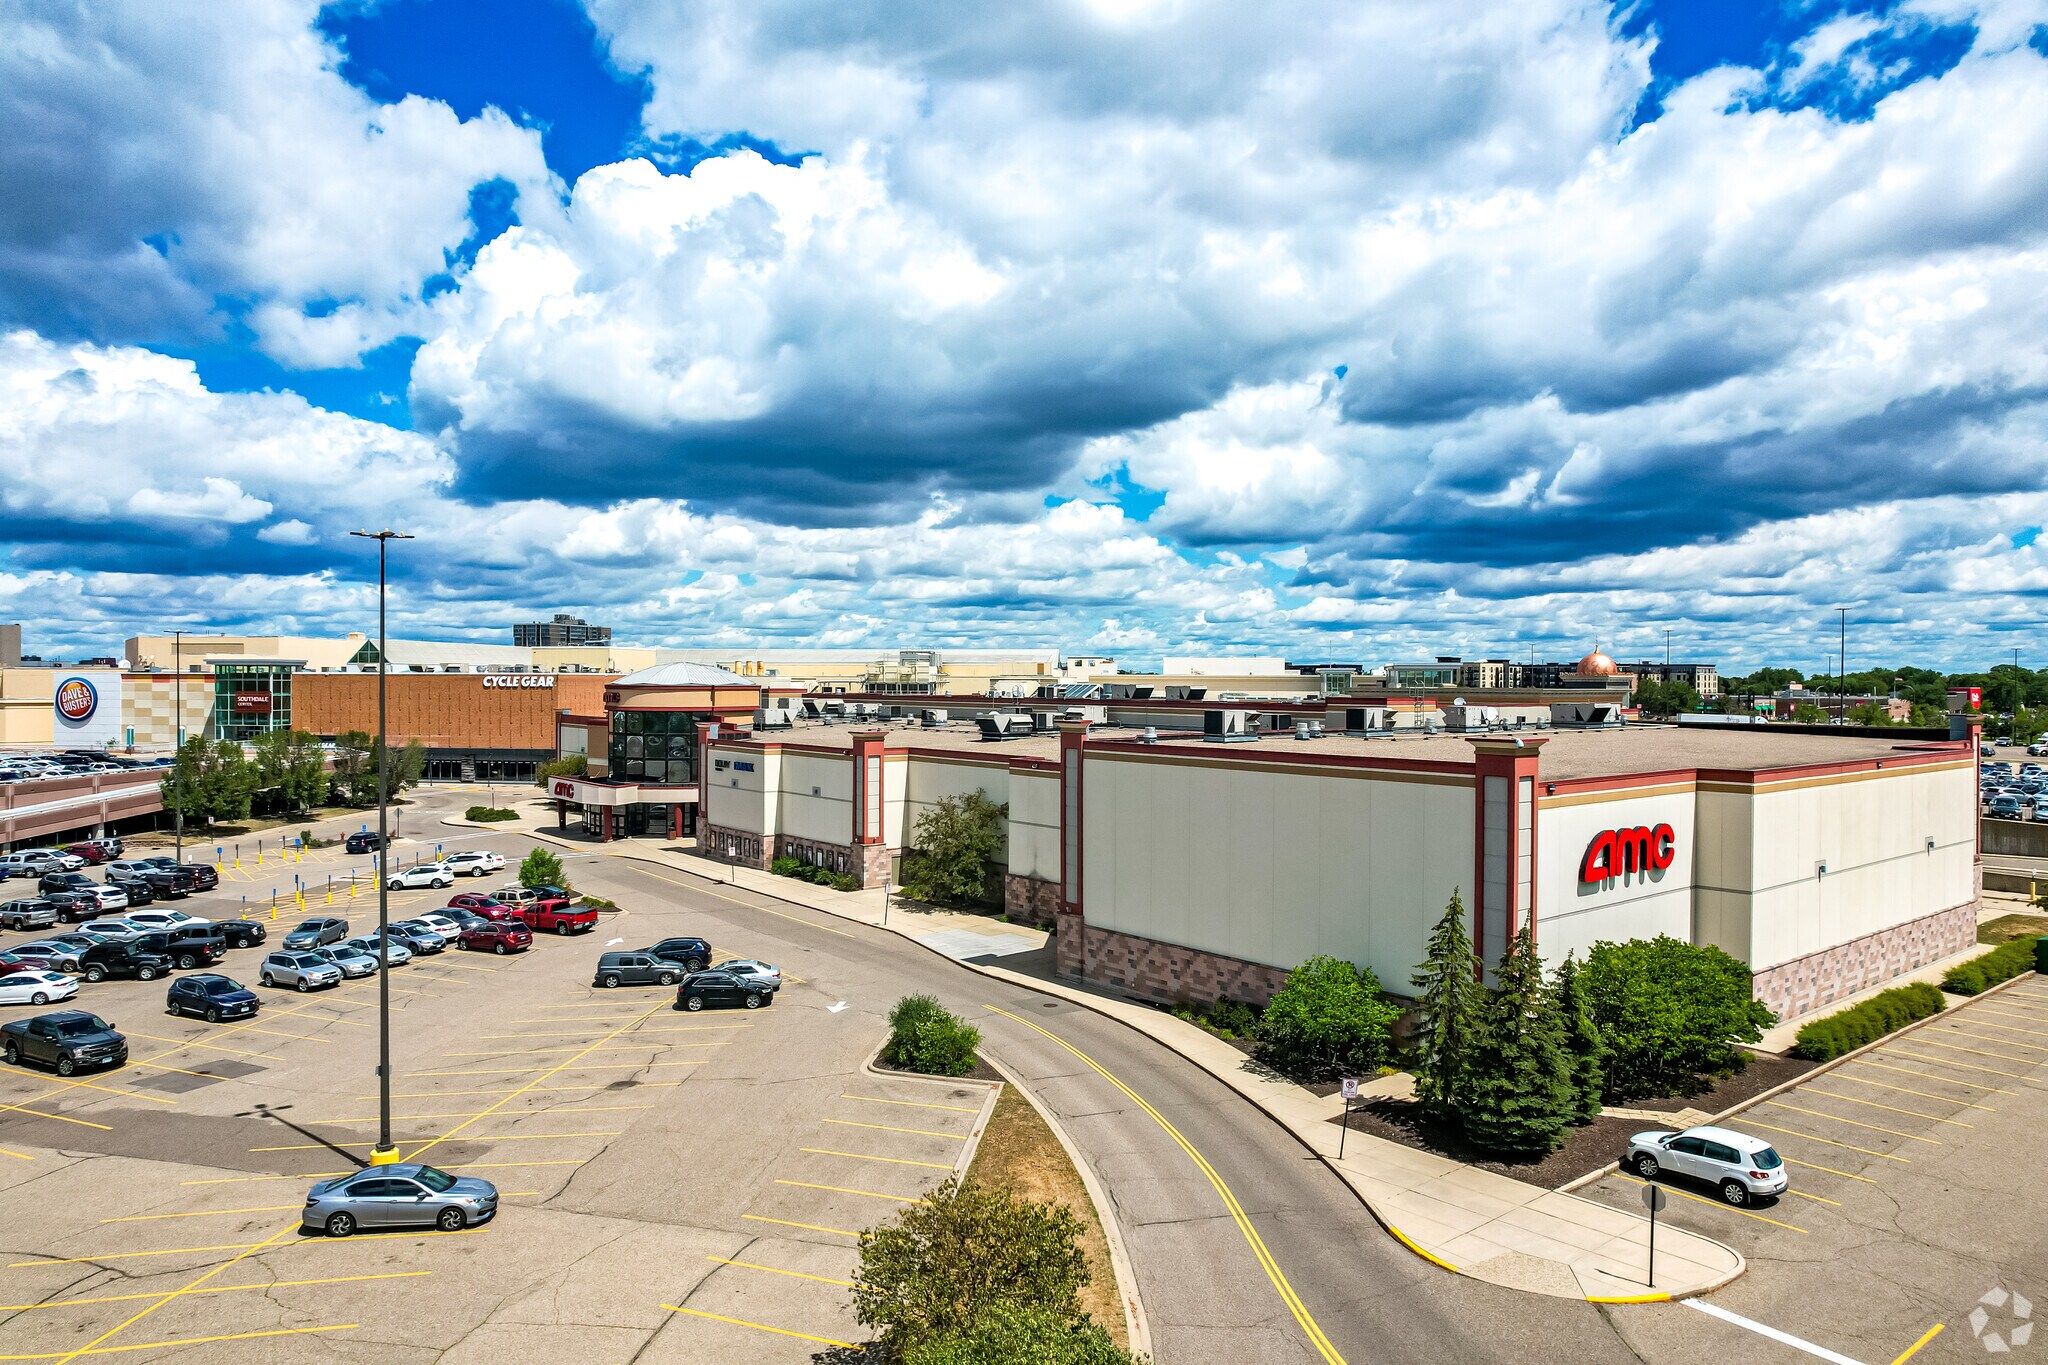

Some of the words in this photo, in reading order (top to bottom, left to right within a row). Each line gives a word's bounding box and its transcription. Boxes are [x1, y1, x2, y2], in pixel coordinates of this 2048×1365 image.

[483, 676, 520, 687] CYCLE
[62, 688, 83, 702] DAVE
[82, 686, 91, 697] &
